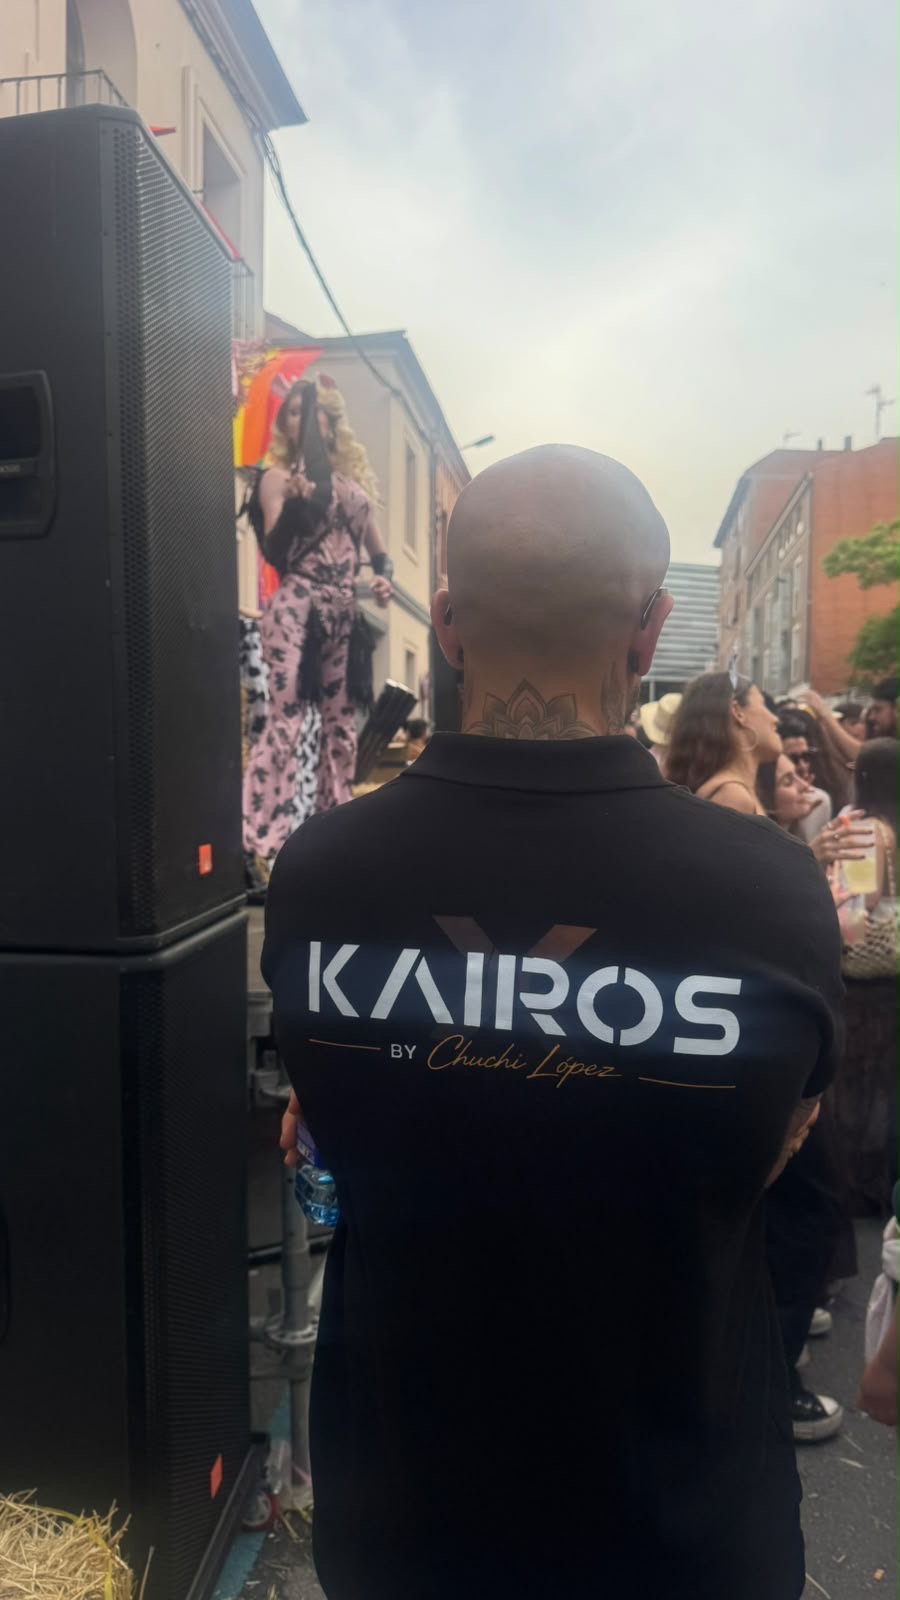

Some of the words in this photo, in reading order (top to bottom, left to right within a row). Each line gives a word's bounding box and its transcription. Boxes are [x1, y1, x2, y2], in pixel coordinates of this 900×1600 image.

[308, 941, 742, 1056] KAIROS
[390, 1043, 417, 1059] BY
[427, 1034, 526, 1070] Chuchi
[526, 1043, 622, 1088] López
